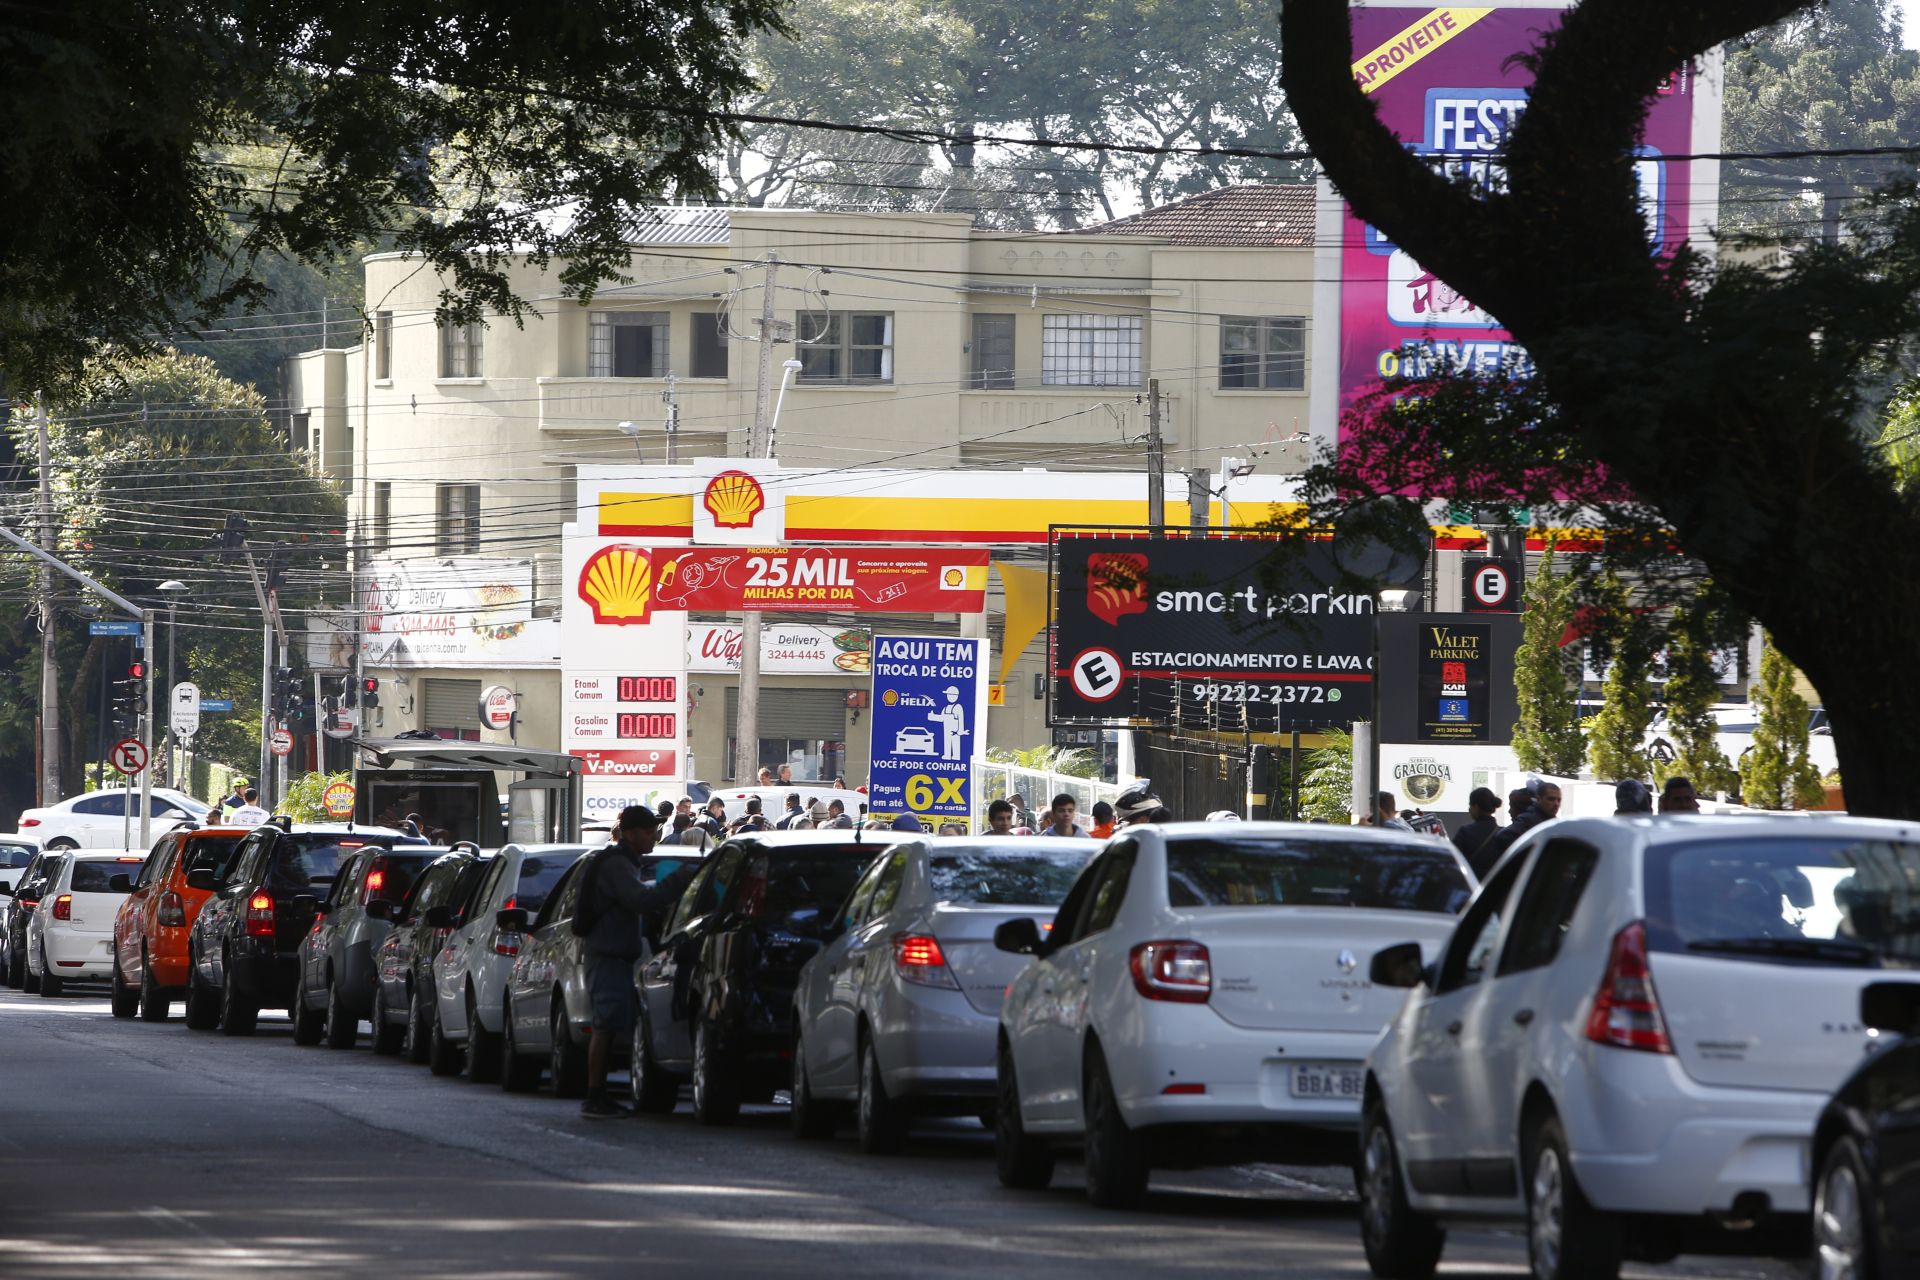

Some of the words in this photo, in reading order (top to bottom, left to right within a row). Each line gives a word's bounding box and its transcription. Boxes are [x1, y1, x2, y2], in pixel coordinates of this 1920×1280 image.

[1354, 11, 1457, 87] APROVEITE
[1434, 99, 1528, 151] FEST
[745, 557, 789, 587] 25
[791, 557, 854, 586] MIL
[1484, 574, 1498, 595] E
[409, 588, 446, 607] Delivery
[743, 588, 794, 599] MILHAS
[798, 588, 826, 599] POR
[830, 588, 854, 599] DIA
[1156, 586, 1257, 613] smart
[778, 635, 820, 646] Delivery
[767, 650, 826, 660] 3244-4445
[878, 640, 930, 660] AQUI
[936, 643, 973, 661] TEM
[1430, 649, 1479, 659] PARKING
[1131, 651, 1298, 669] ESTACIONAMENTO
[1303, 655, 1312, 669] E
[1317, 655, 1362, 669] LAVA
[876, 664, 918, 677] TROCA
[921, 665, 937, 677] DE
[940, 663, 974, 678] ÓLEO
[574, 679, 599, 688] Etanol
[620, 678, 676, 700] 0.000
[574, 690, 603, 699] Comum
[991, 689, 1000, 700] 7
[1192, 683, 1324, 704] 99222-2372
[900, 696, 937, 707] HELIX
[574, 715, 609, 725] Gasolina
[620, 714, 676, 737] 0.000
[574, 727, 603, 736] Comum
[586, 760, 656, 773] V-Power
[873, 758, 897, 768] VOCÊ
[900, 761, 924, 770] PODE
[926, 762, 967, 771] CONFIAR
[1394, 764, 1451, 780] GRACIOSA
[873, 784, 901, 794] Pague
[586, 797, 639, 809] cosan
[889, 799, 904, 807] até
